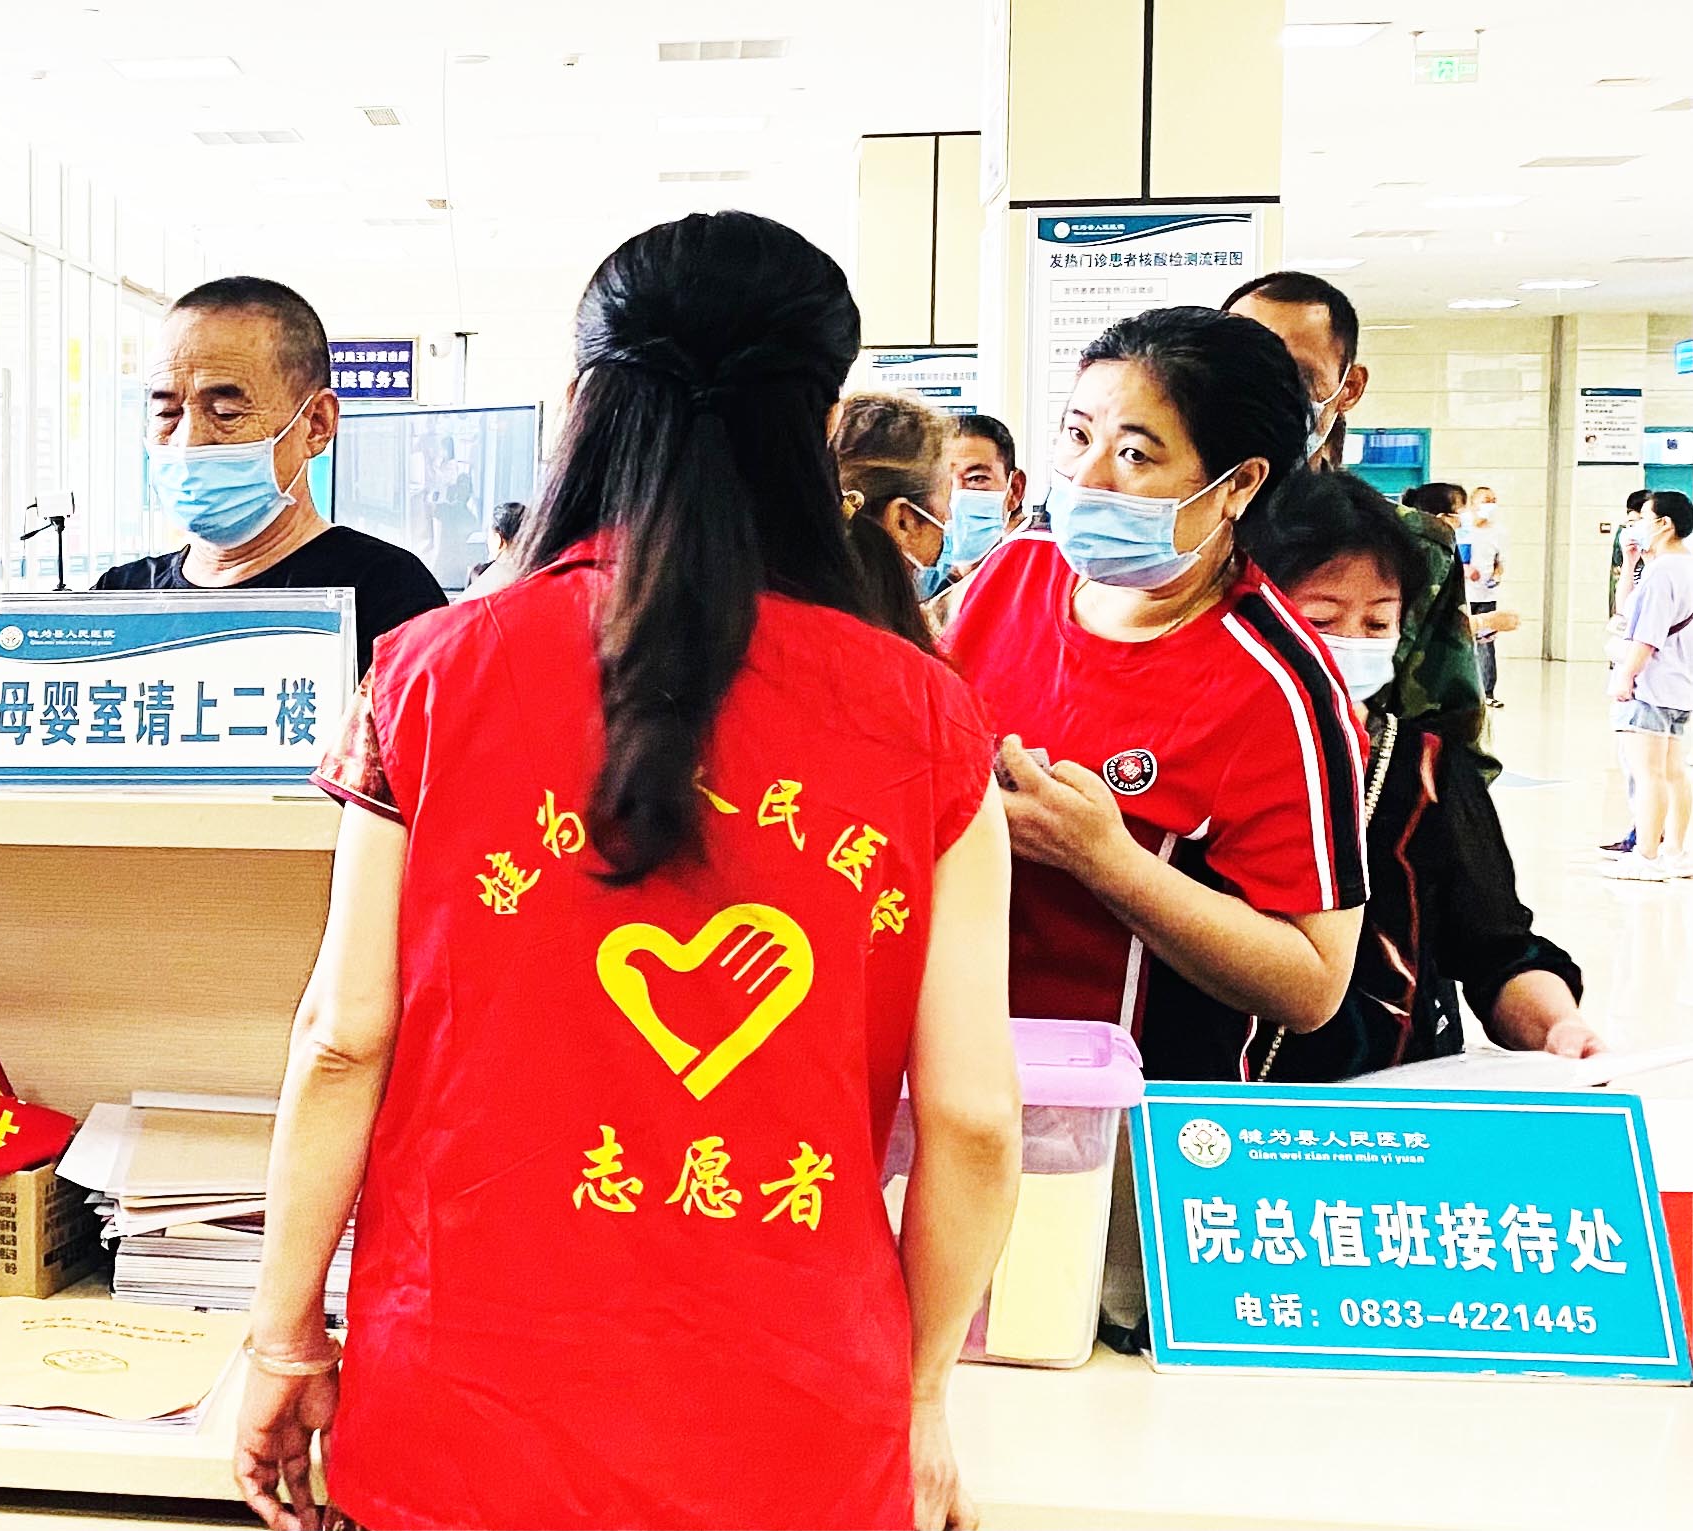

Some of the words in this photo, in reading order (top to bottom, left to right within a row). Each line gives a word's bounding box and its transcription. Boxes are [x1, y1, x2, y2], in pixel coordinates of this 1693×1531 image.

[1049, 251, 1243, 268] 发热门诊患者核酸检测流程图
[1238, 1128, 1431, 1149] 犍为县人民医院
[572, 1124, 835, 1231] 志愿者
[1183, 1196, 1628, 1275] 院总值班接待处
